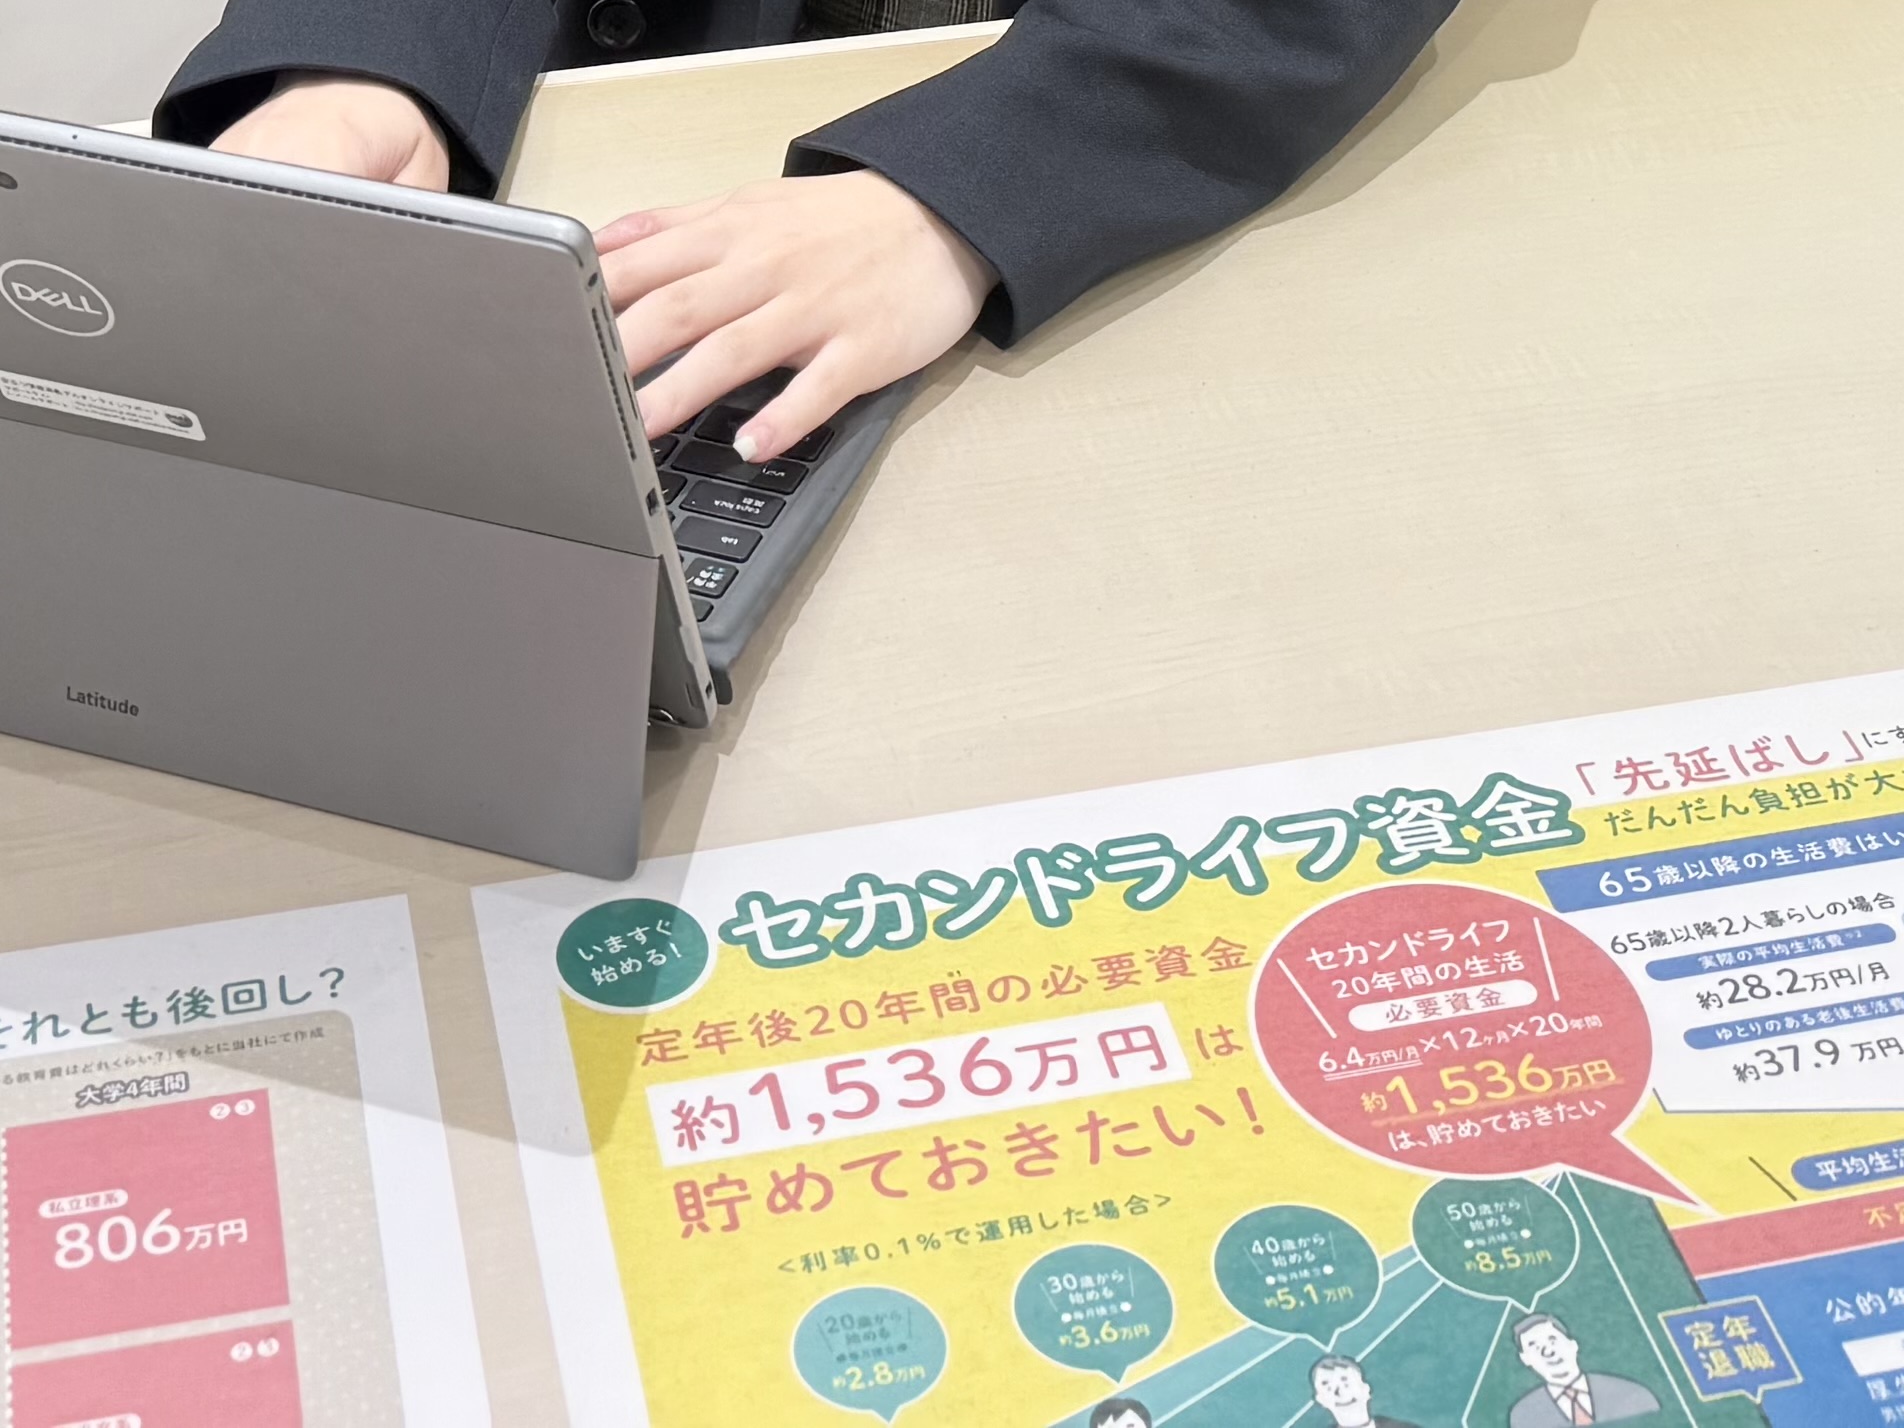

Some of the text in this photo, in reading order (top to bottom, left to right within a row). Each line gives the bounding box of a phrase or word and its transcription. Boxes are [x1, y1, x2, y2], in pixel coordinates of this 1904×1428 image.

[11, 281, 103, 315] DELL
[66, 685, 139, 717] Latitude
[724, 776, 1580, 964] セカンドライフ資金
[577, 919, 672, 962] いますぐ
[1610, 891, 1896, 955] 65歳以降2人暮らしの場合
[1306, 919, 1511, 972] セカンドライフ
[590, 942, 682, 986] 始める!
[1331, 950, 1526, 999] 20年間の生活
[639, 935, 1252, 1067] 定年後20年間の必要資金
[1695, 961, 1891, 1011] 約28.2万円/月
[1385, 987, 1506, 1024] 必要資金
[77, 1072, 190, 1109] 大学4年間
[670, 1023, 1170, 1154] 約1,536万円
[1359, 1052, 1616, 1116] 約1,536万円
[1387, 1099, 1607, 1153] は、貯めておきたい
[671, 1085, 1268, 1241] 貯めておきたい!
[47, 1191, 119, 1215] 私立理系
[1446, 1199, 1522, 1223] 50歳から
[54, 1207, 248, 1269] 806万円
[1468, 1215, 1513, 1233] 始める
[1251, 1231, 1326, 1256] 40歳から
[1272, 1250, 1316, 1268] 始める
[1464, 1246, 1553, 1274] 約8.5万円
[1046, 1267, 1125, 1294] 30歳から
[1068, 1286, 1115, 1305] 始める
[1264, 1283, 1354, 1311] 約5.1万円
[824, 1309, 902, 1333] 20歳から
[844, 1326, 891, 1346] 始める
[1058, 1319, 1151, 1349] 約3.6万円
[1684, 1314, 1757, 1350] 定年
[832, 1360, 926, 1390] 約2.8万円
[1698, 1342, 1776, 1380] 退職
